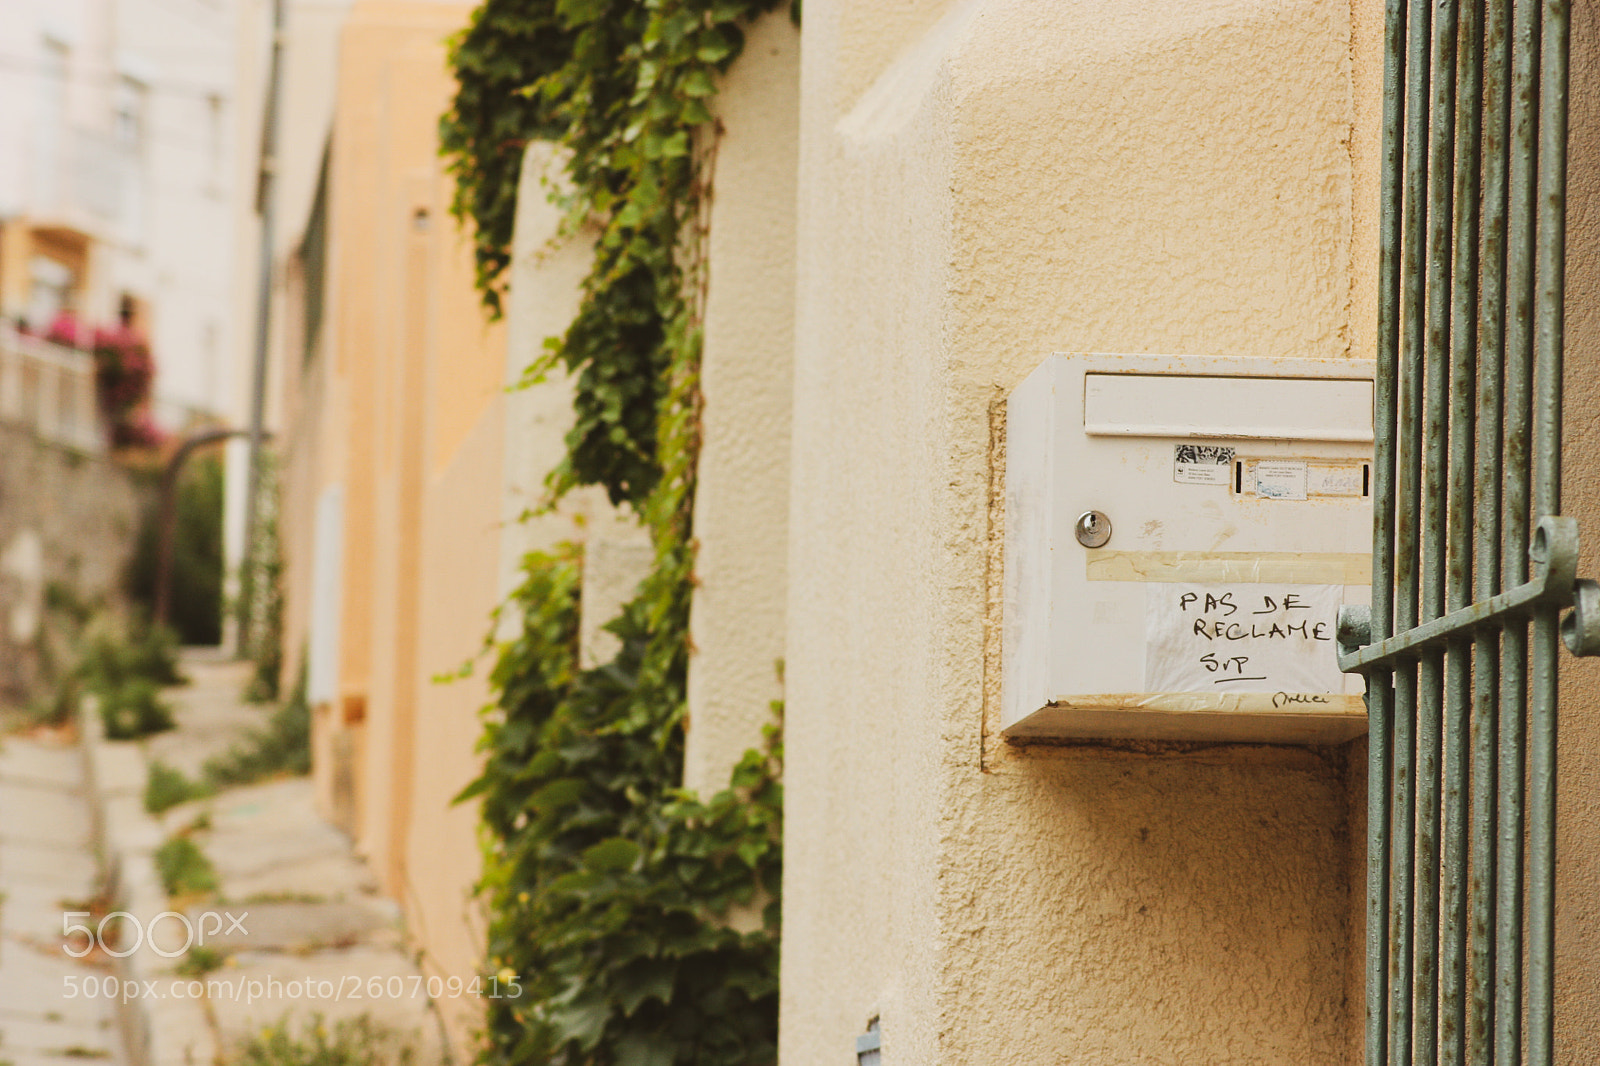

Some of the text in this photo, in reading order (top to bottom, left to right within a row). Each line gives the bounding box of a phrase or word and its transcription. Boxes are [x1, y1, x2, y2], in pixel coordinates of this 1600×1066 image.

[1180, 592, 1312, 616] PAS DE
[1194, 618, 1331, 640] RECLAME
